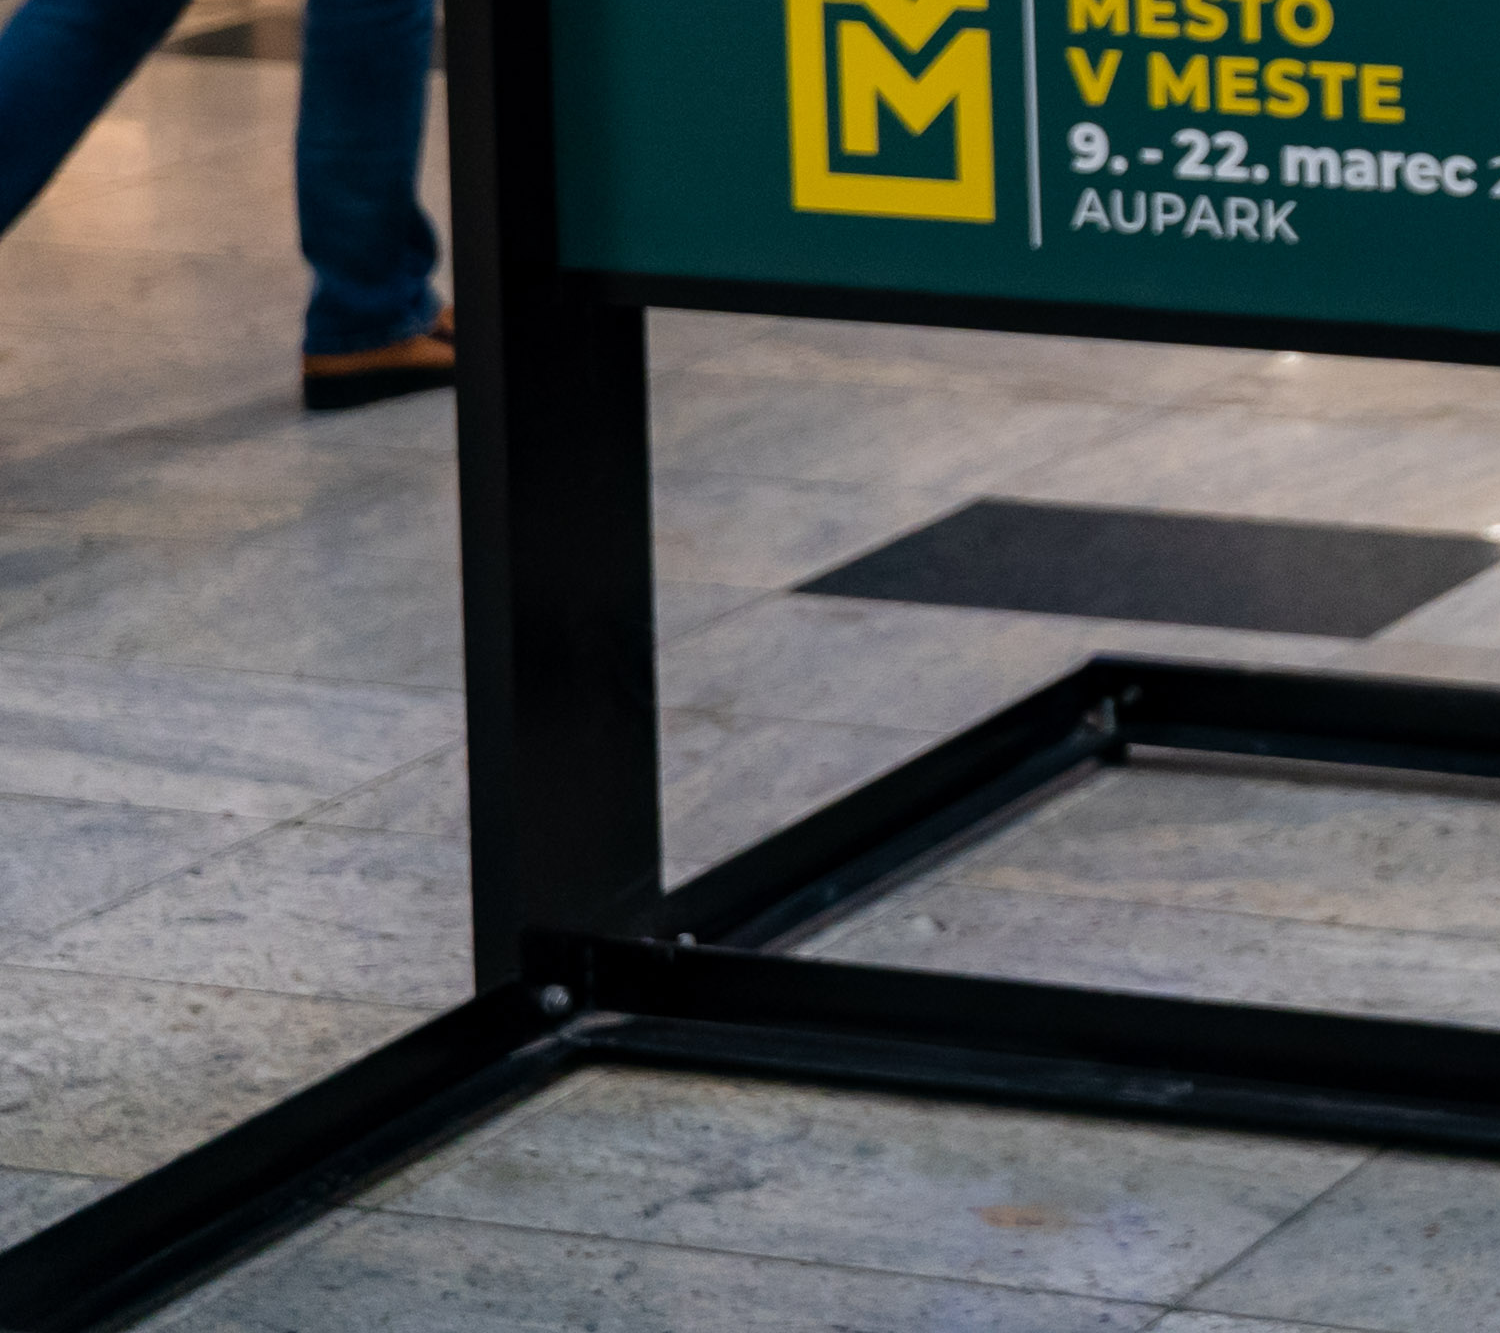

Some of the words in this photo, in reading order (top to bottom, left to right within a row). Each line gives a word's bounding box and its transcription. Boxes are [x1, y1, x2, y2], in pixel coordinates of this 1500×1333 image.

[1066, 48, 1124, 107] V
[1149, 53, 1405, 123] MESTE
[1069, 122, 1127, 174] 9.
[1172, 129, 1269, 183] 22.
[1283, 145, 1477, 196] marec
[1072, 189, 1299, 244] AUPARK
